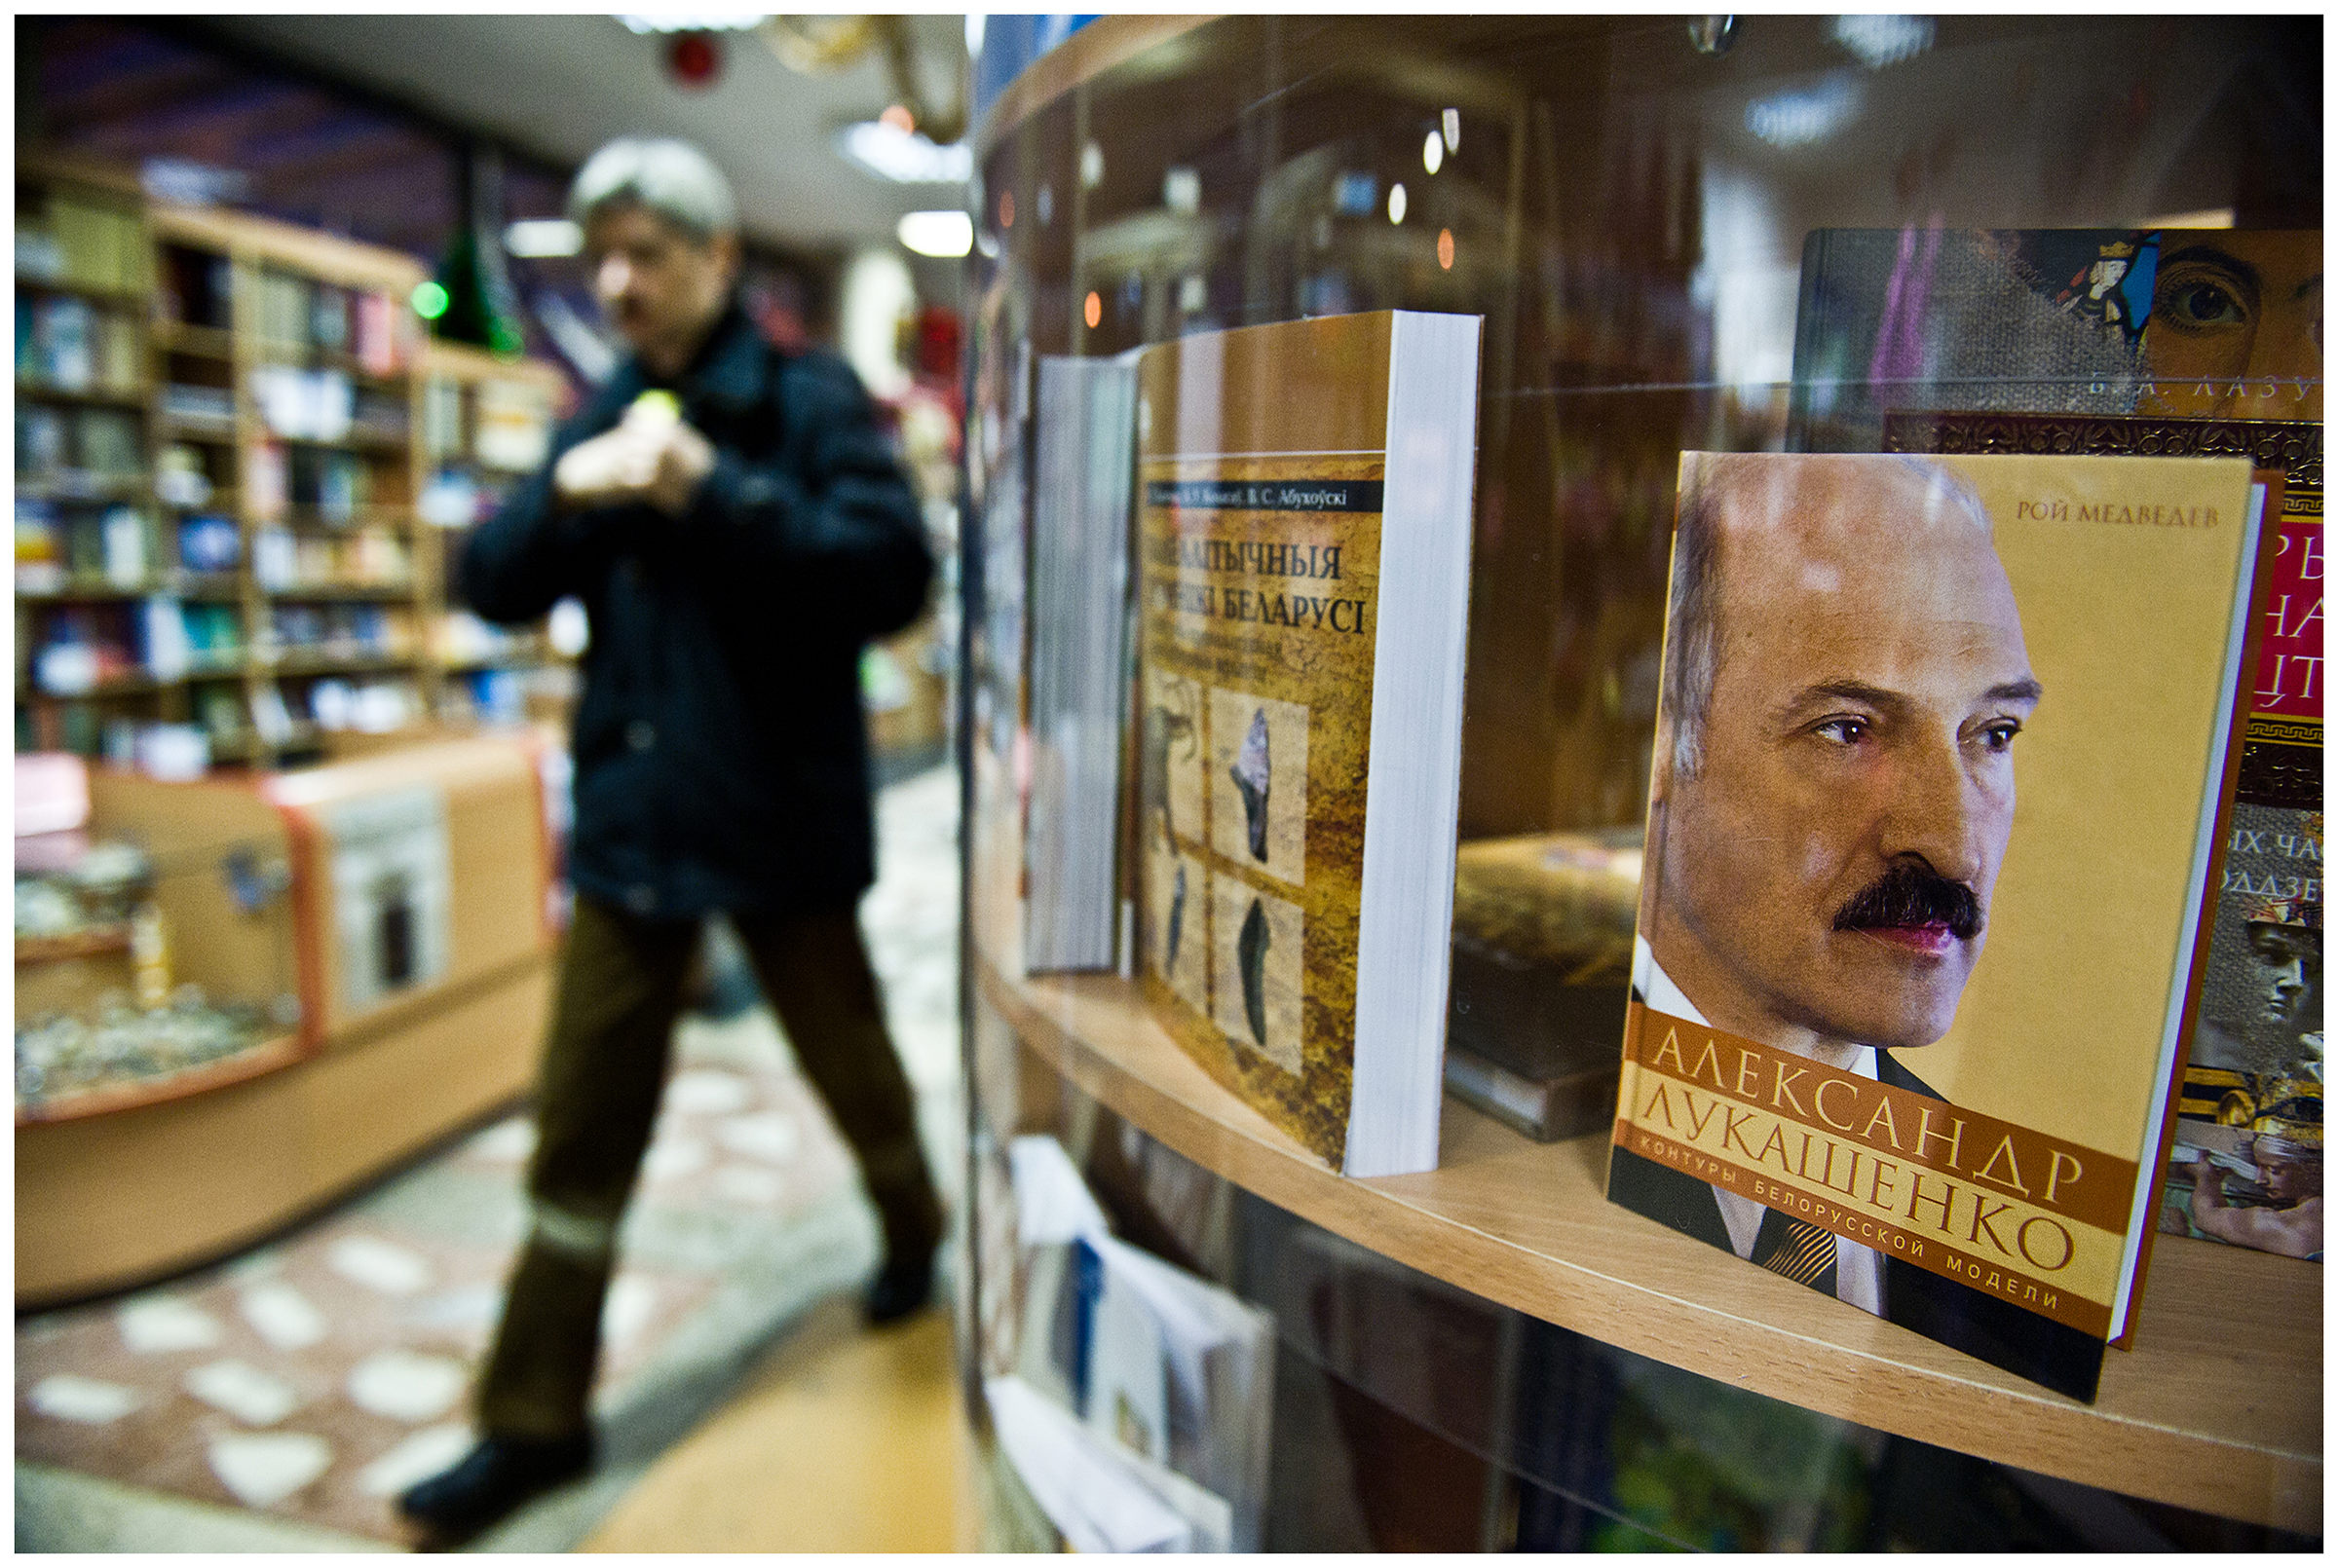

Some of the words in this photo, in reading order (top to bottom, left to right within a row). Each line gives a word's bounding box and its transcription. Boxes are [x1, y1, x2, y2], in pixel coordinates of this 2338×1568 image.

[2017, 499, 2069, 522] РОЙ
[2078, 504, 2220, 528] МЕДВЕДЕВ
[1223, 586, 1367, 634] БЕЛАРУСІ
[1642, 1082, 2077, 1272] ЛУКАШЕНКО
[1652, 1026, 2084, 1204] АЛЕКСАНДР
[1640, 1136, 1737, 1182] КОНТУРЫ
[1754, 1179, 1925, 1258] БЕЛОРУССКОЙ
[1945, 1253, 2059, 1311] МОДЕЛИ
